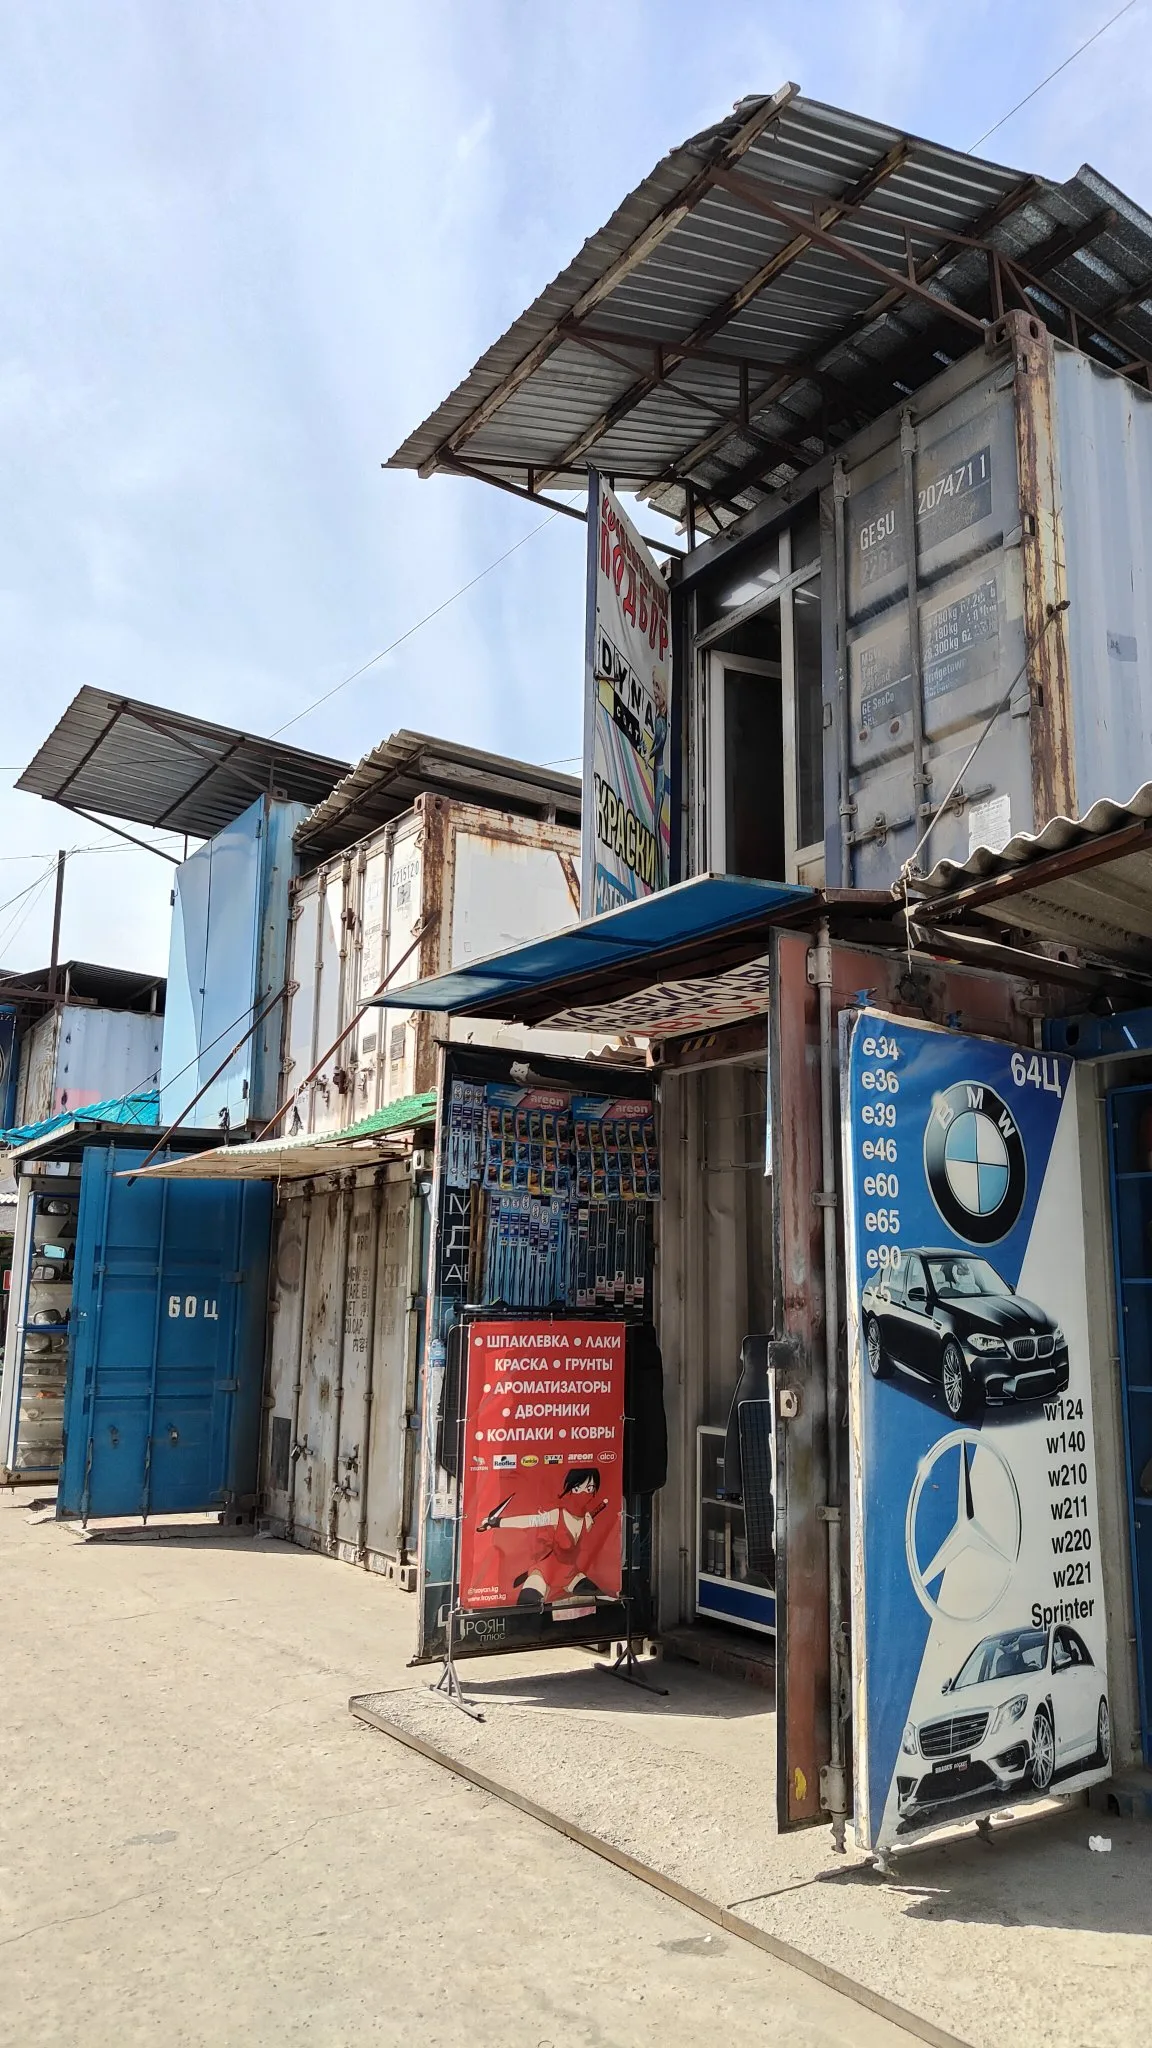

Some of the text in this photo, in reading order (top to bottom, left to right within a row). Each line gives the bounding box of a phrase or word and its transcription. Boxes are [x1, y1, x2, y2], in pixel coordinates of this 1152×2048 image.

[860, 510, 895, 550] GESU
[601, 521, 668, 661] ПОДБОР
[602, 637, 655, 735] DYNA
[594, 772, 656, 890] КРАСКИ
[862, 1036, 899, 1061] e34
[862, 1068, 899, 1094] e36
[1011, 1053, 1062, 1098] 64Ц
[531, 1094, 564, 1107] areon
[616, 1104, 648, 1113] areon
[935, 1086, 1016, 1138] BMW
[862, 1102, 896, 1128] e39
[862, 1138, 898, 1163] e46
[864, 1172, 898, 1198] e60
[865, 1208, 900, 1234] e65
[866, 1244, 902, 1270] e90
[486, 1334, 620, 1349] ШПАКЛЕВКА ЛАКИ
[495, 1358, 613, 1372] КРАСКА ГРУНТЫ
[494, 1381, 611, 1395] АРОМАТИЗАТОРЫ
[515, 1403, 590, 1420] ДВОРНИКИ
[1044, 1398, 1084, 1422] w124
[486, 1426, 615, 1441] КОЛПАКИ КОВРЫ
[1046, 1432, 1086, 1454] w140
[1048, 1463, 1088, 1488] w210
[1050, 1496, 1088, 1520] w211
[1052, 1528, 1092, 1554] w220
[1053, 1562, 1092, 1588] w221
[1031, 1598, 1095, 1633] Sprinter
